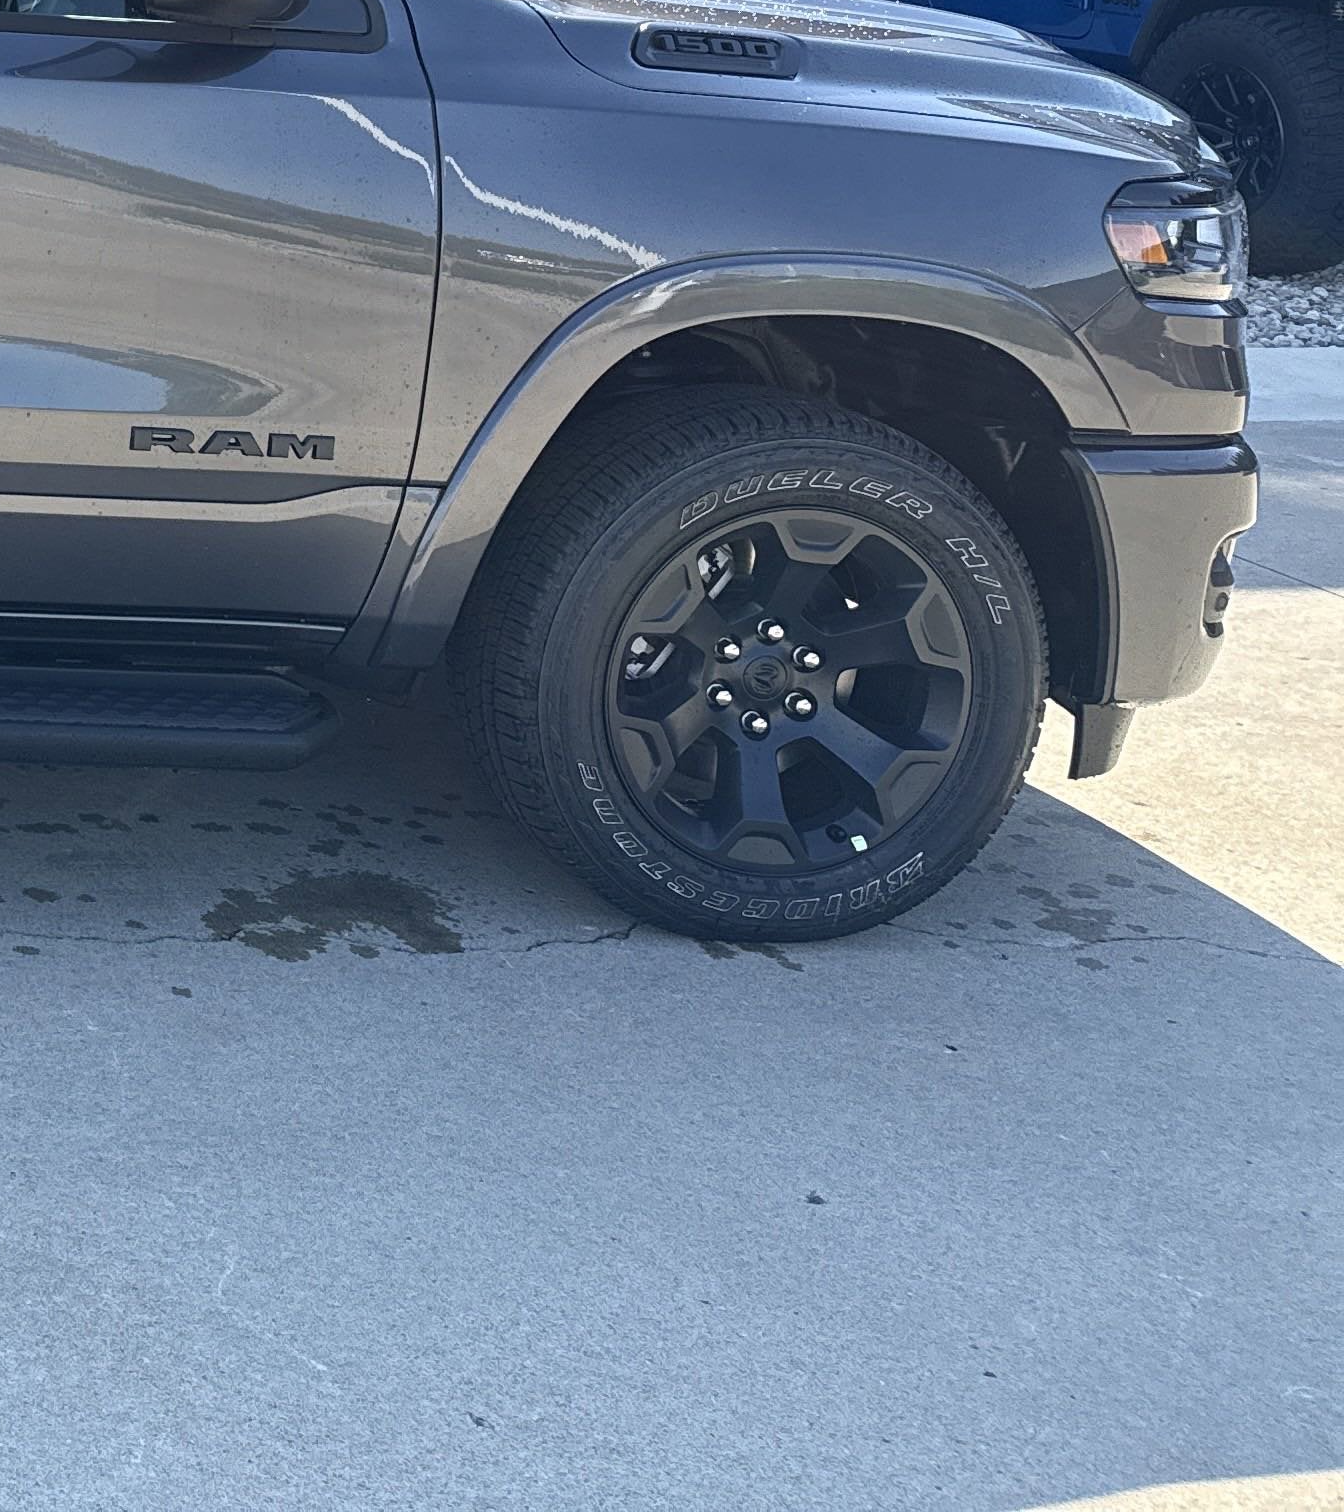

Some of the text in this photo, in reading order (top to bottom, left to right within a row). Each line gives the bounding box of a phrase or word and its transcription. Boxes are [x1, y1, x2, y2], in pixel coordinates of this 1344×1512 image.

[658, 34, 777, 58] 1500
[129, 426, 335, 460] RAM
[679, 468, 1015, 626] DUELER H/L
[575, 760, 925, 923] BRIDGESTONE
